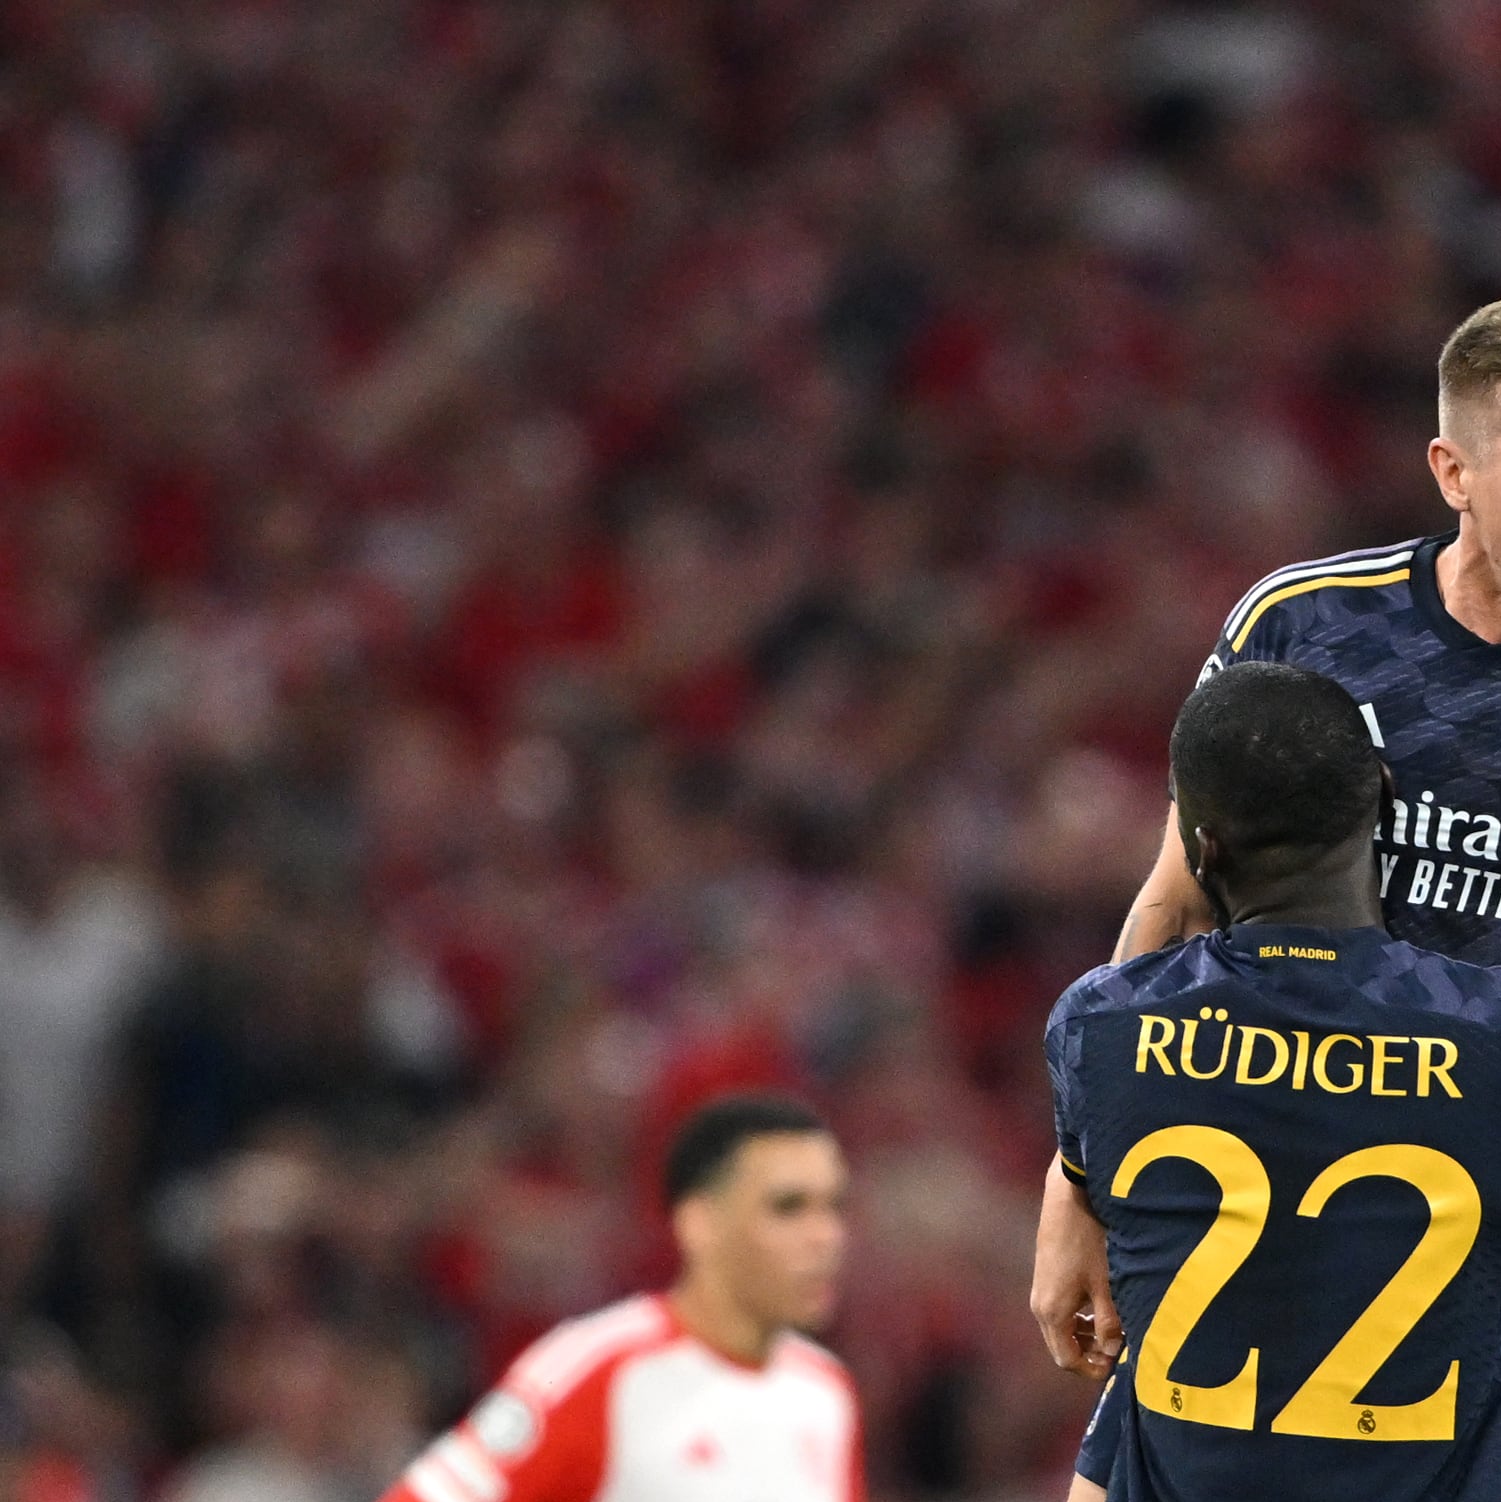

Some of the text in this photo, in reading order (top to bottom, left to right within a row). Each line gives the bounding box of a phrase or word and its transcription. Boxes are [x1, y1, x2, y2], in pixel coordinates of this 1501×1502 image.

[1259, 946, 1336, 961] REAL MADRID
[1135, 1006, 1464, 1099] RÜDIGER
[1110, 1124, 1482, 1441] 22
